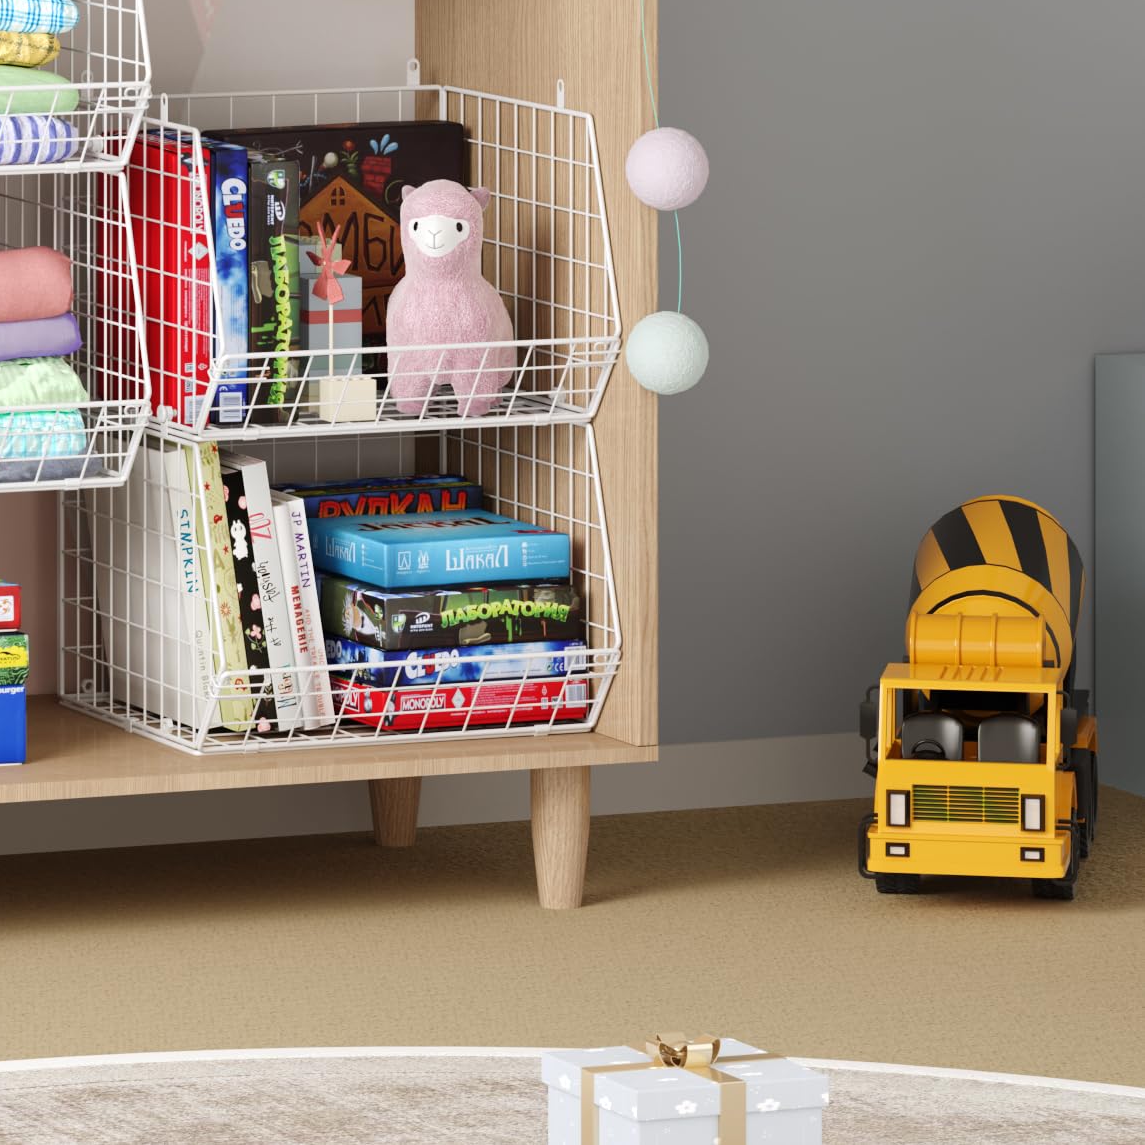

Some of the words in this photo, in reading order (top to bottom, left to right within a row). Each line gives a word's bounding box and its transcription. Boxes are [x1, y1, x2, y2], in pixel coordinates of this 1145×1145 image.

[221, 178, 247, 251] CLUEDO
[267, 235, 293, 405] ЛАБОРАТОРИЯ
[291, 511, 303, 526] JP
[294, 532, 311, 588] MARTIN
[265, 616, 278, 634] the
[290, 585, 309, 655] MENAGERIE
[440, 599, 571, 628] ЛАБОРАТОРИЯ
[405, 649, 459, 679] CLUEDO
[402, 696, 445, 711] MONOPOLY
